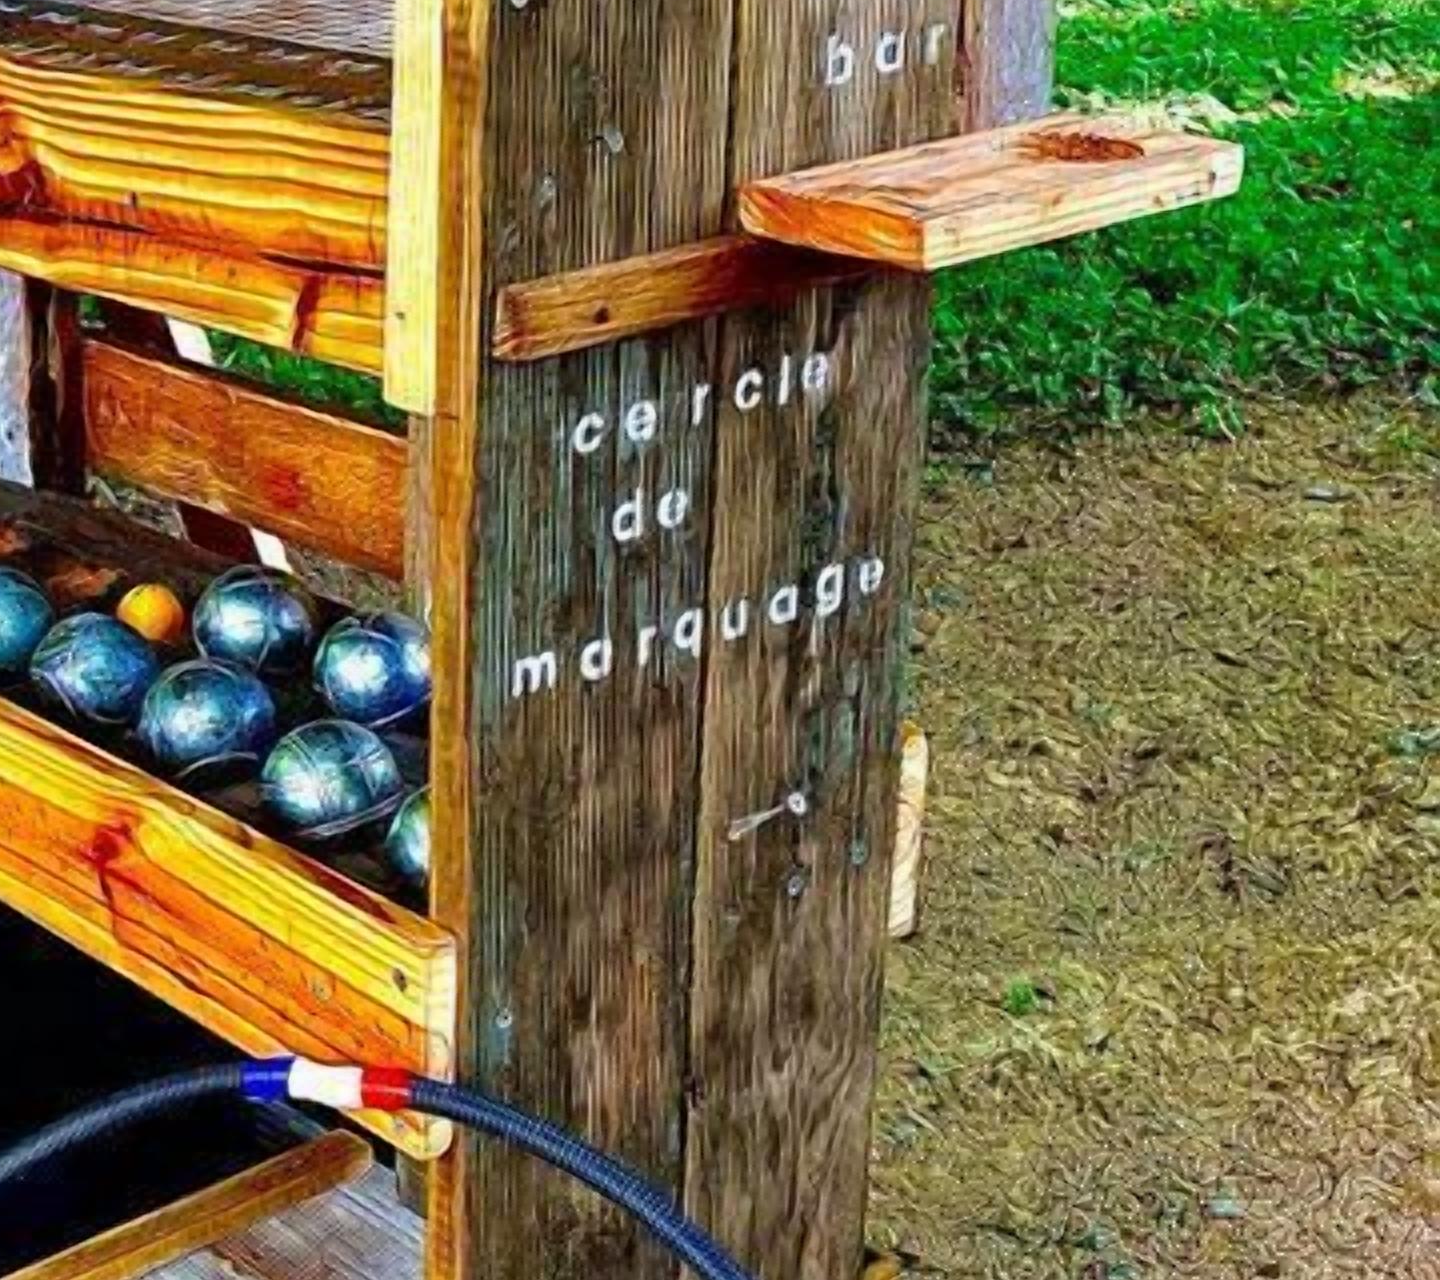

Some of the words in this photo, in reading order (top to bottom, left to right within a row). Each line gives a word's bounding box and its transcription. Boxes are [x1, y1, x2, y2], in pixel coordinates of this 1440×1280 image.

[824, 23, 946, 85] bar
[574, 353, 829, 454] cercle
[612, 486, 688, 542] de
[511, 558, 884, 697] marquage
